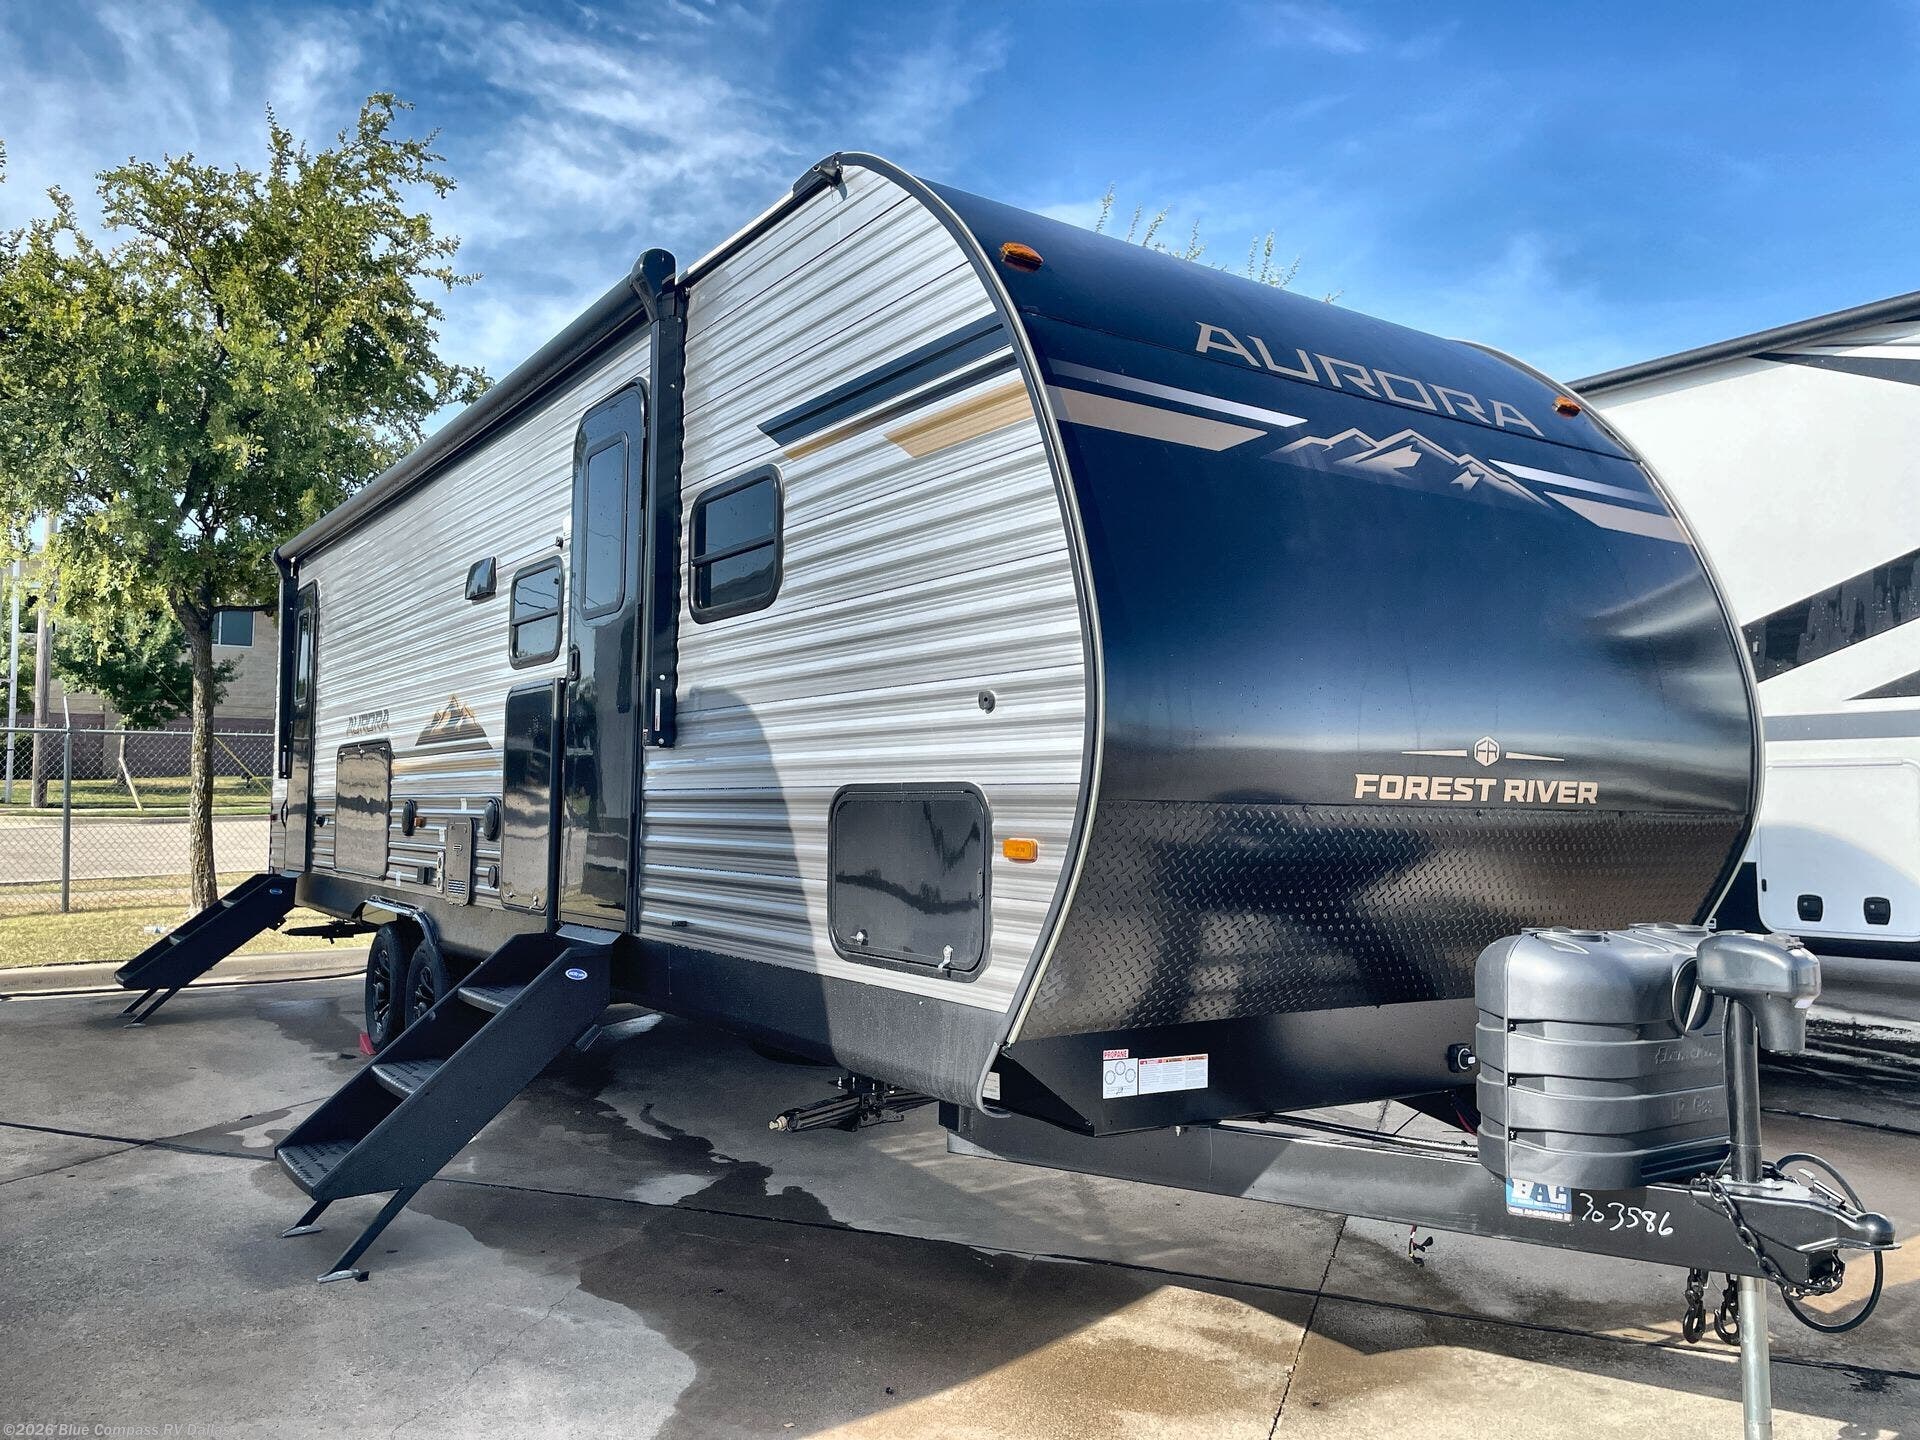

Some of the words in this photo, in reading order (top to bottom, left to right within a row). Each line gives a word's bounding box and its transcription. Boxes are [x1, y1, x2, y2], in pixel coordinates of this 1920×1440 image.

[1195, 321, 1546, 437] AURORA
[1354, 773, 1498, 802] FOREST
[1504, 779, 1599, 804] RIVER
